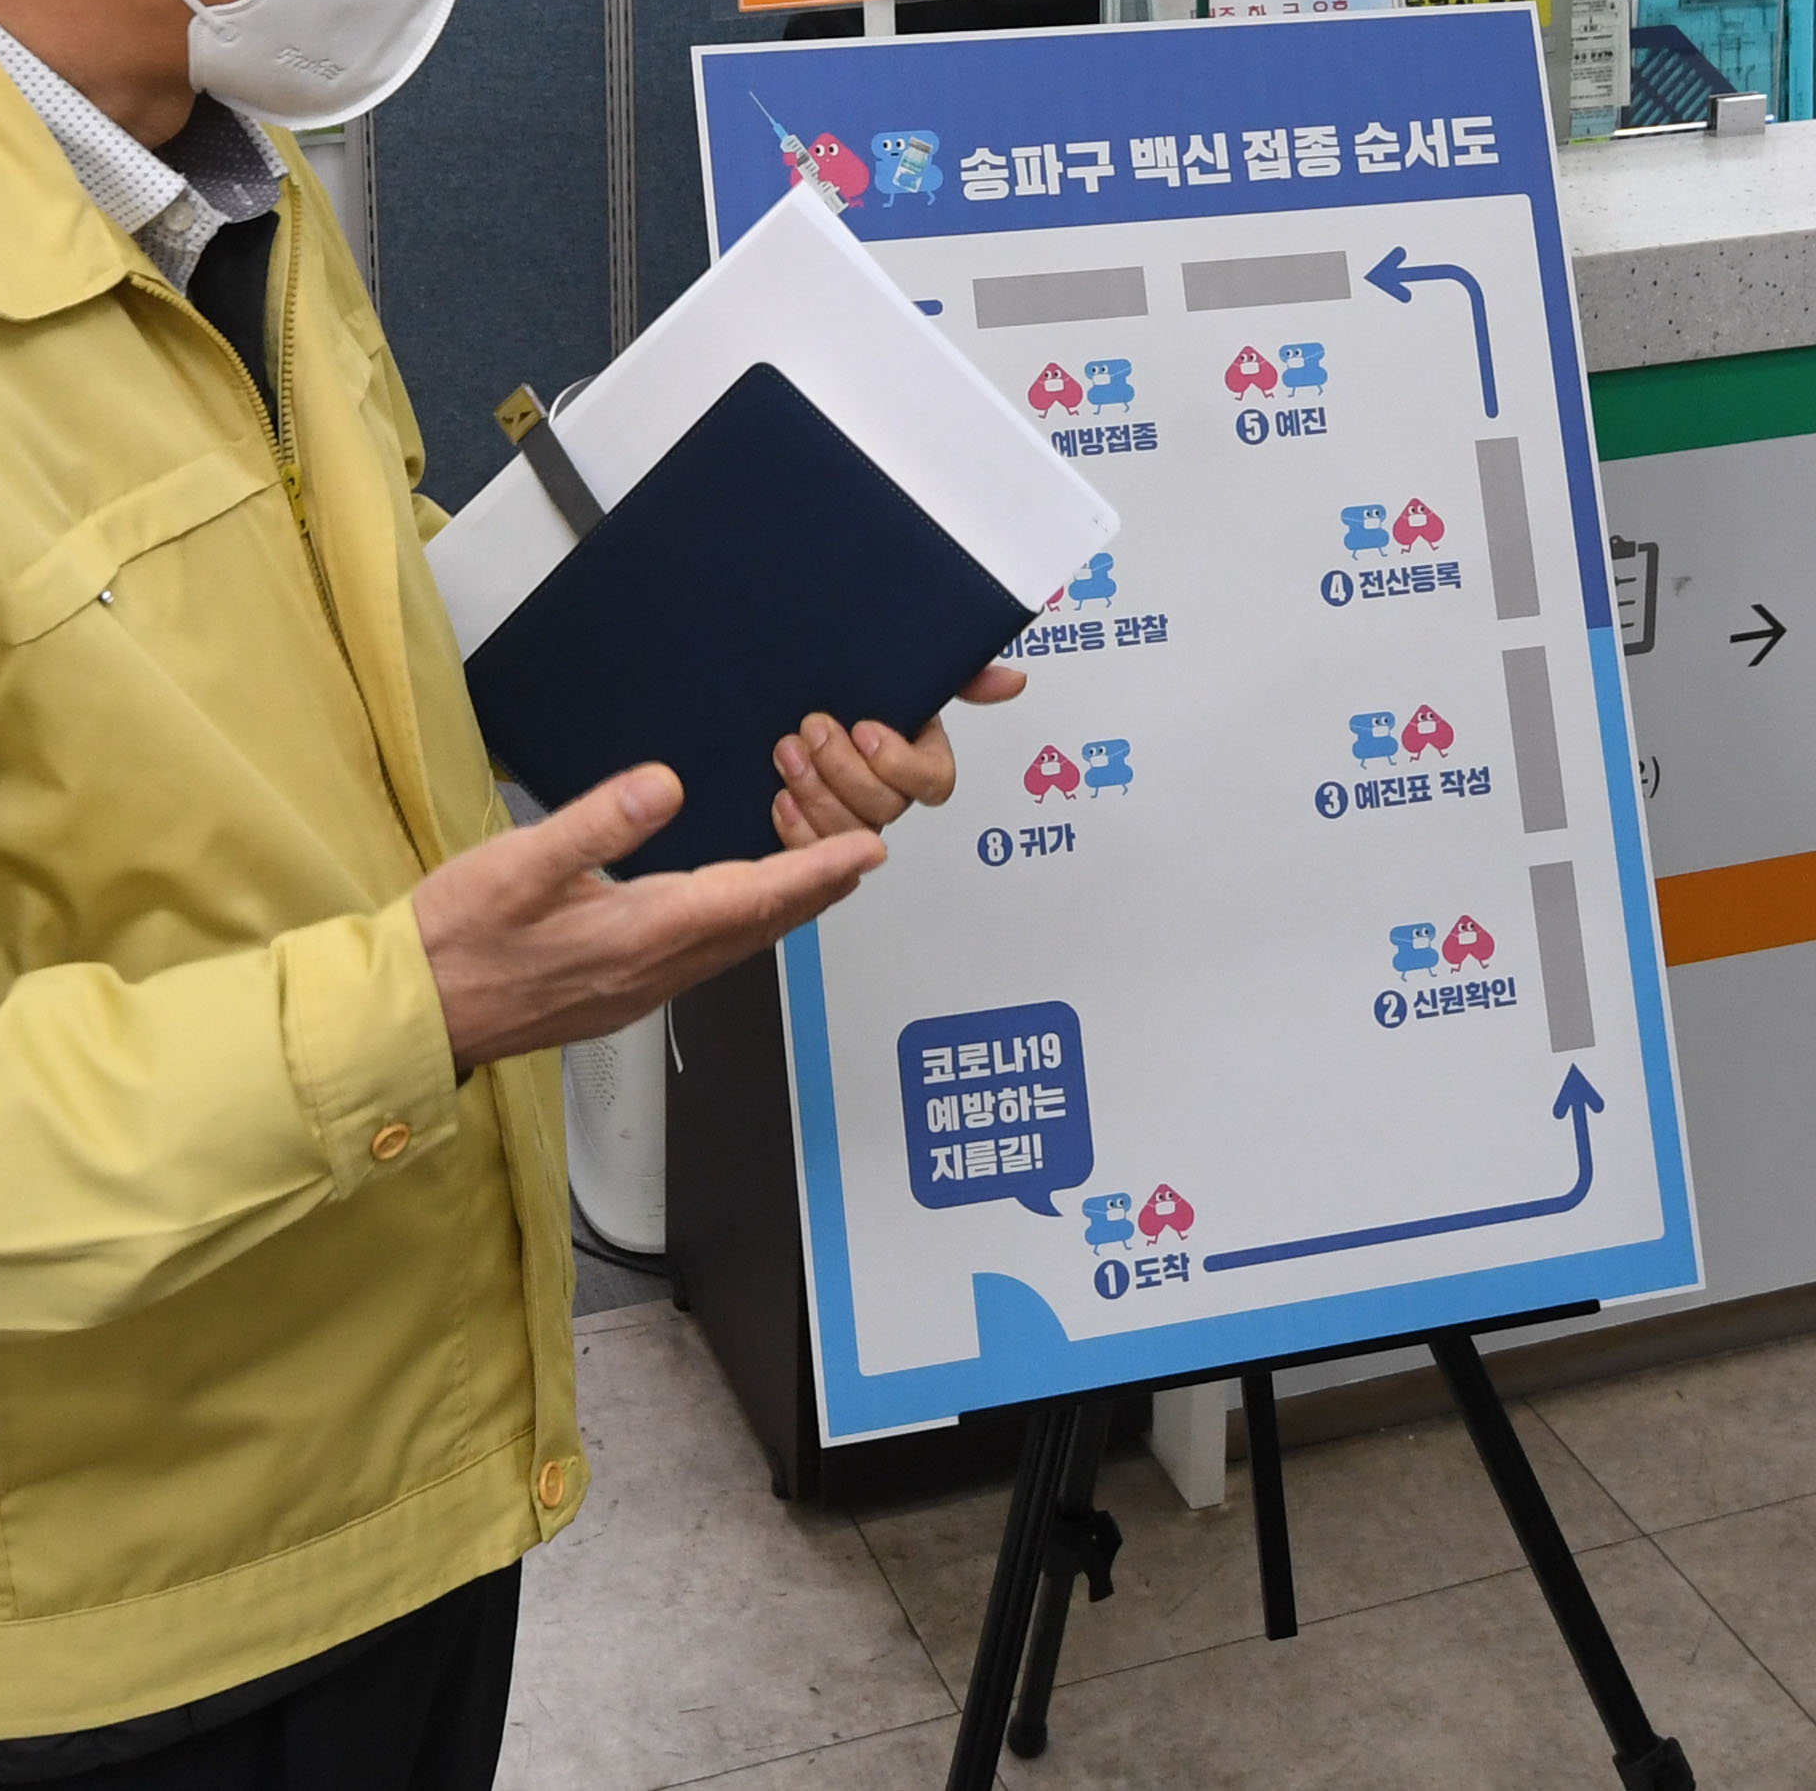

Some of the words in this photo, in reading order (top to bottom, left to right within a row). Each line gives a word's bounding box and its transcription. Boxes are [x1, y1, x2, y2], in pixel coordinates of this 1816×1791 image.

[960, 144, 1115, 202] 송파구
[1131, 132, 1232, 189] 백신
[1242, 123, 1344, 183] 접종
[1353, 115, 1500, 173] 순서도
[1051, 421, 1159, 460] 예방접종
[1275, 407, 1327, 440] 예진
[1359, 560, 1462, 600] 전산등록
[1115, 614, 1169, 649] 관찰
[1353, 771, 1433, 809] 예진표
[1440, 765, 1493, 802] 작성
[1019, 823, 1076, 860] 귀가
[1412, 977, 1518, 1020] 신원확인
[920, 1032, 1063, 1086] 코로나19
[926, 1083, 1068, 1135] 예방하는
[930, 1132, 1045, 1183] 지름길!
[1134, 1251, 1192, 1291] 도착
